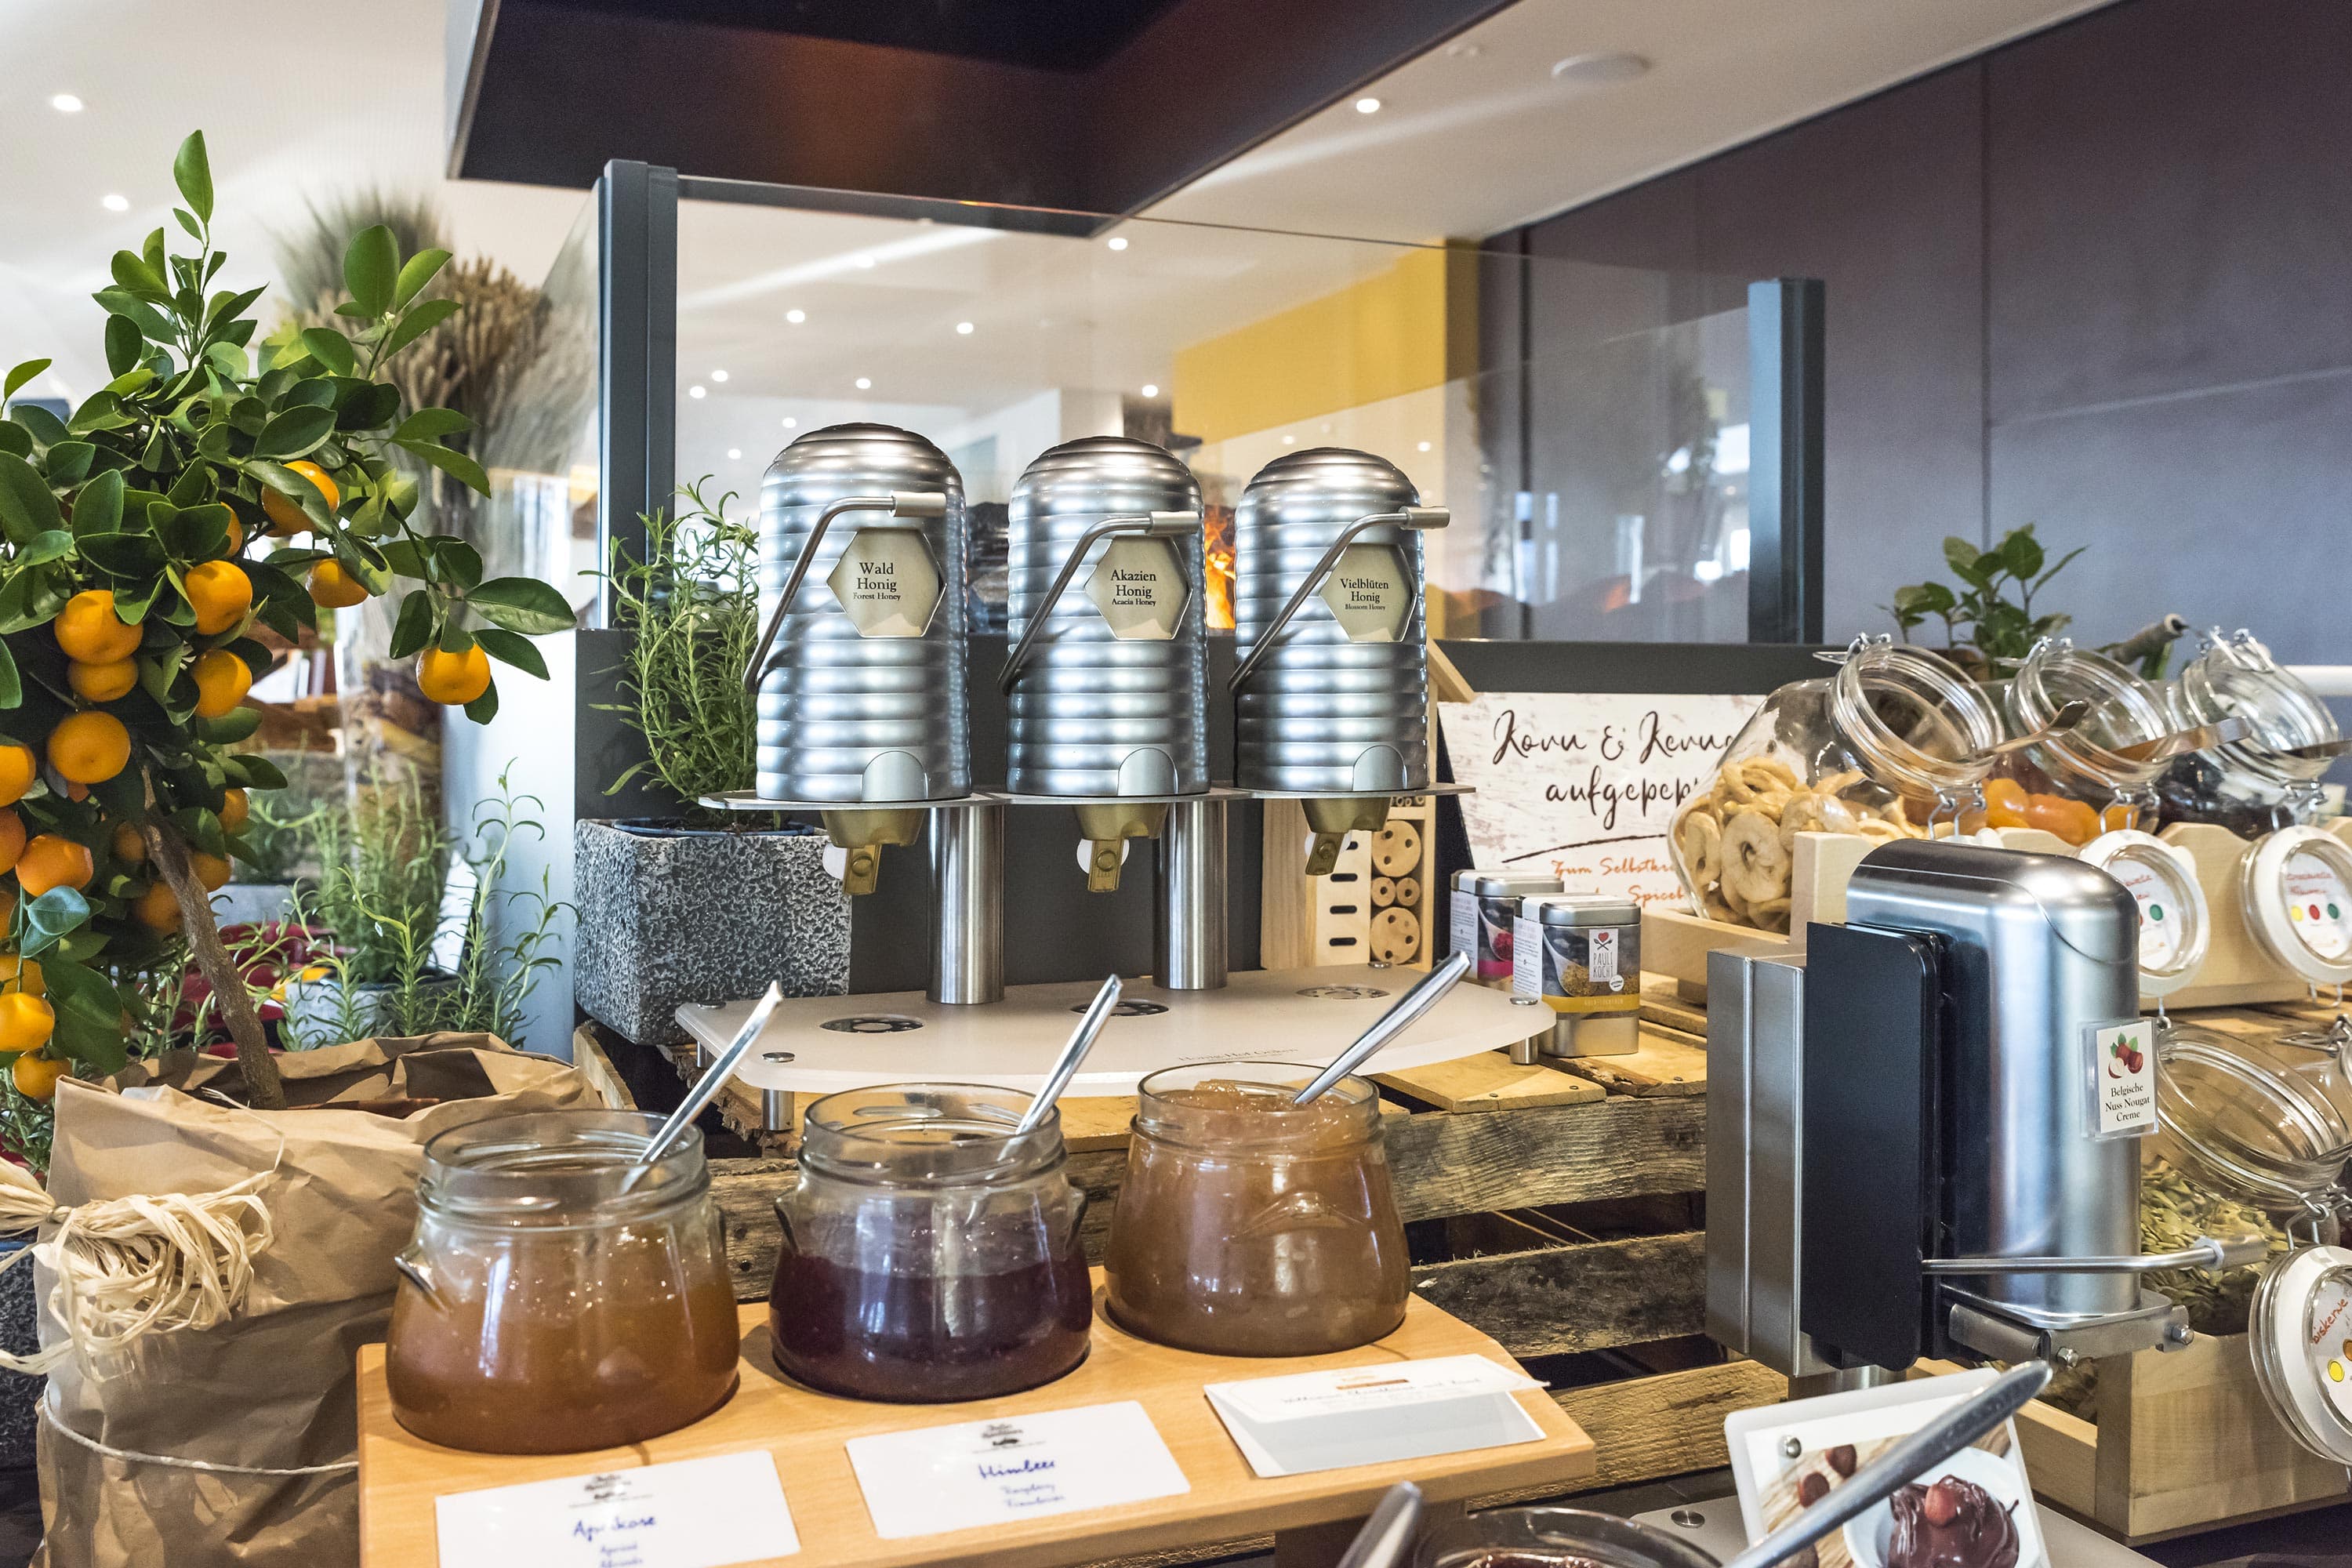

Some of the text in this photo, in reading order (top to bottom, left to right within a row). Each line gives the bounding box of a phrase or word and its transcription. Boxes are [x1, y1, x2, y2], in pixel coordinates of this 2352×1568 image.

[858, 561, 895, 575] Wald
[1110, 568, 1156, 582] Akazien
[856, 577, 898, 593] Honig
[1339, 578, 1389, 590] Vielblüten
[877, 592, 902, 602] Honey
[1116, 584, 1152, 599] Honig
[1350, 590, 1381, 604] Honig
[1135, 598, 1156, 607] Honey
[1544, 764, 1698, 831] aufgepep
[1593, 952, 1613, 965] PAULI
[2111, 1082, 2143, 1098] Belgische
[2104, 1096, 2151, 1112] Nuss Nougat
[2116, 1111, 2141, 1122] Creme
[574, 1515, 656, 1542] Aprkose
